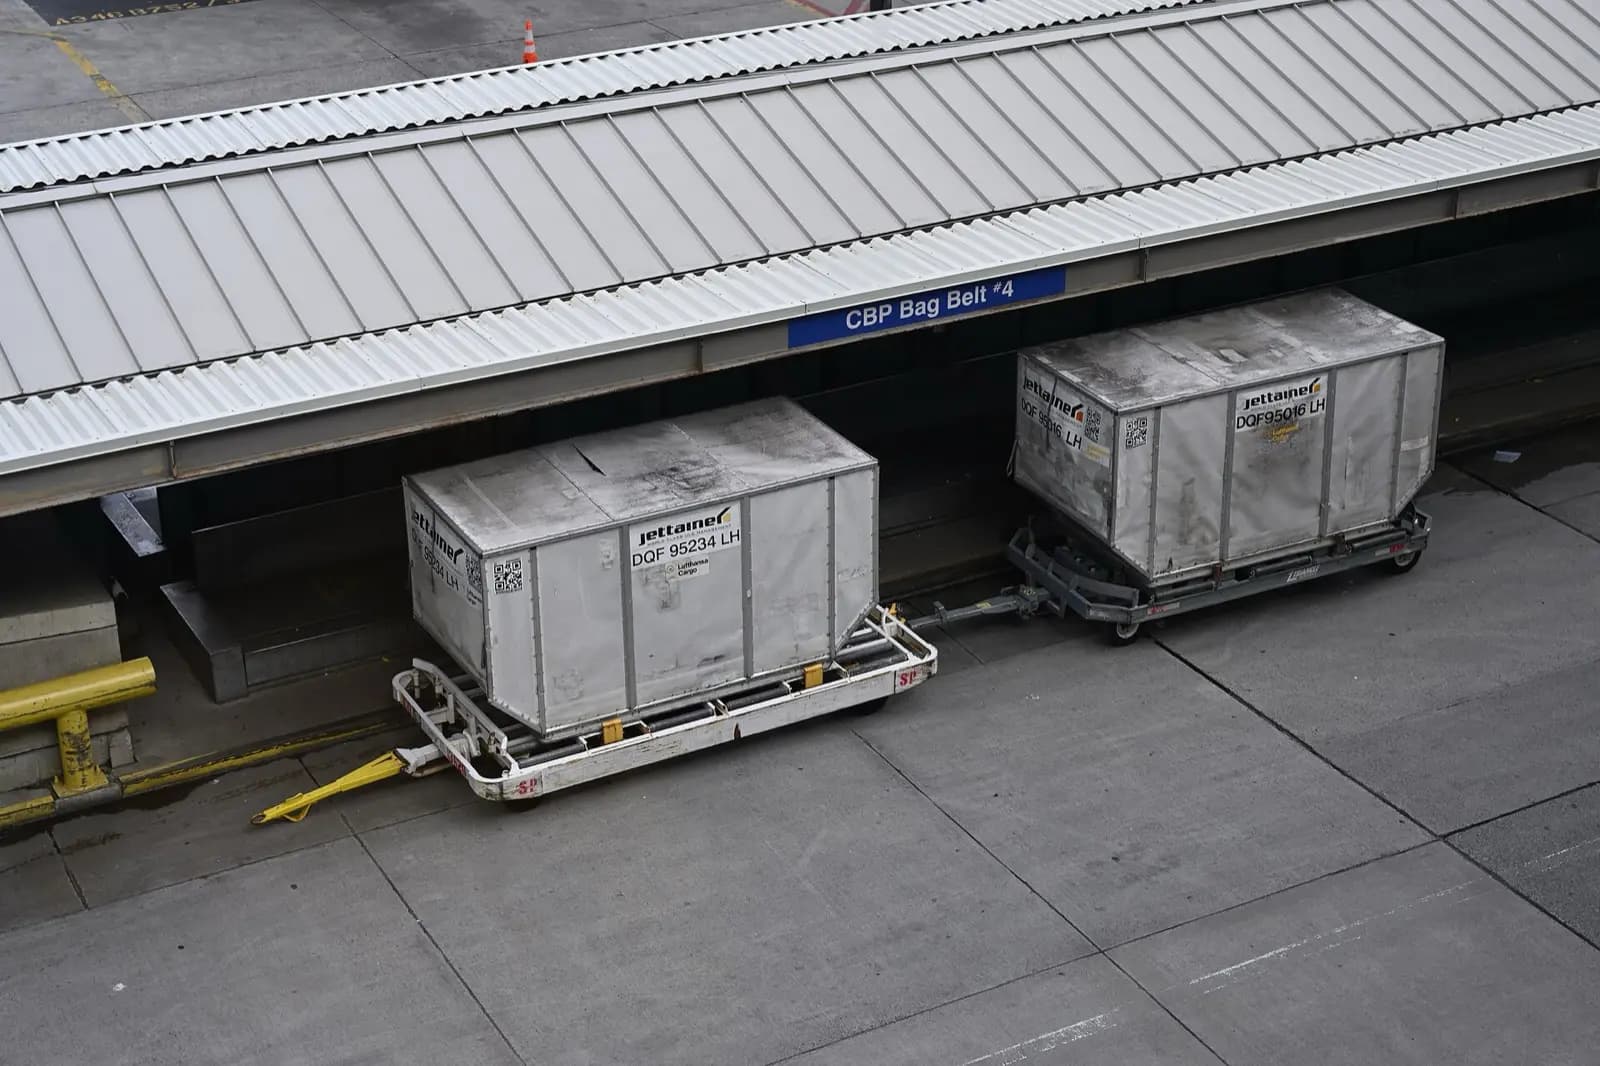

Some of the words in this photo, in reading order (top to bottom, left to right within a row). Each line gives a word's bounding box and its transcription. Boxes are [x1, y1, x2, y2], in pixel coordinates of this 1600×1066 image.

[846, 304, 892, 330] CBP
[900, 298, 940, 319] Bag
[947, 285, 987, 309] Belt
[992, 279, 1014, 298] #4
[1243, 377, 1320, 410] jettainer
[1310, 398, 1326, 414] LH
[1065, 431, 1082, 450] LH
[638, 506, 731, 546] jettainer
[632, 547, 665, 567] DQF
[669, 535, 716, 557] 95234
[721, 529, 740, 546] LH
[677, 558, 709, 571] Lufthansa
[678, 566, 698, 577] Cargo
[446, 570, 459, 591] LH
